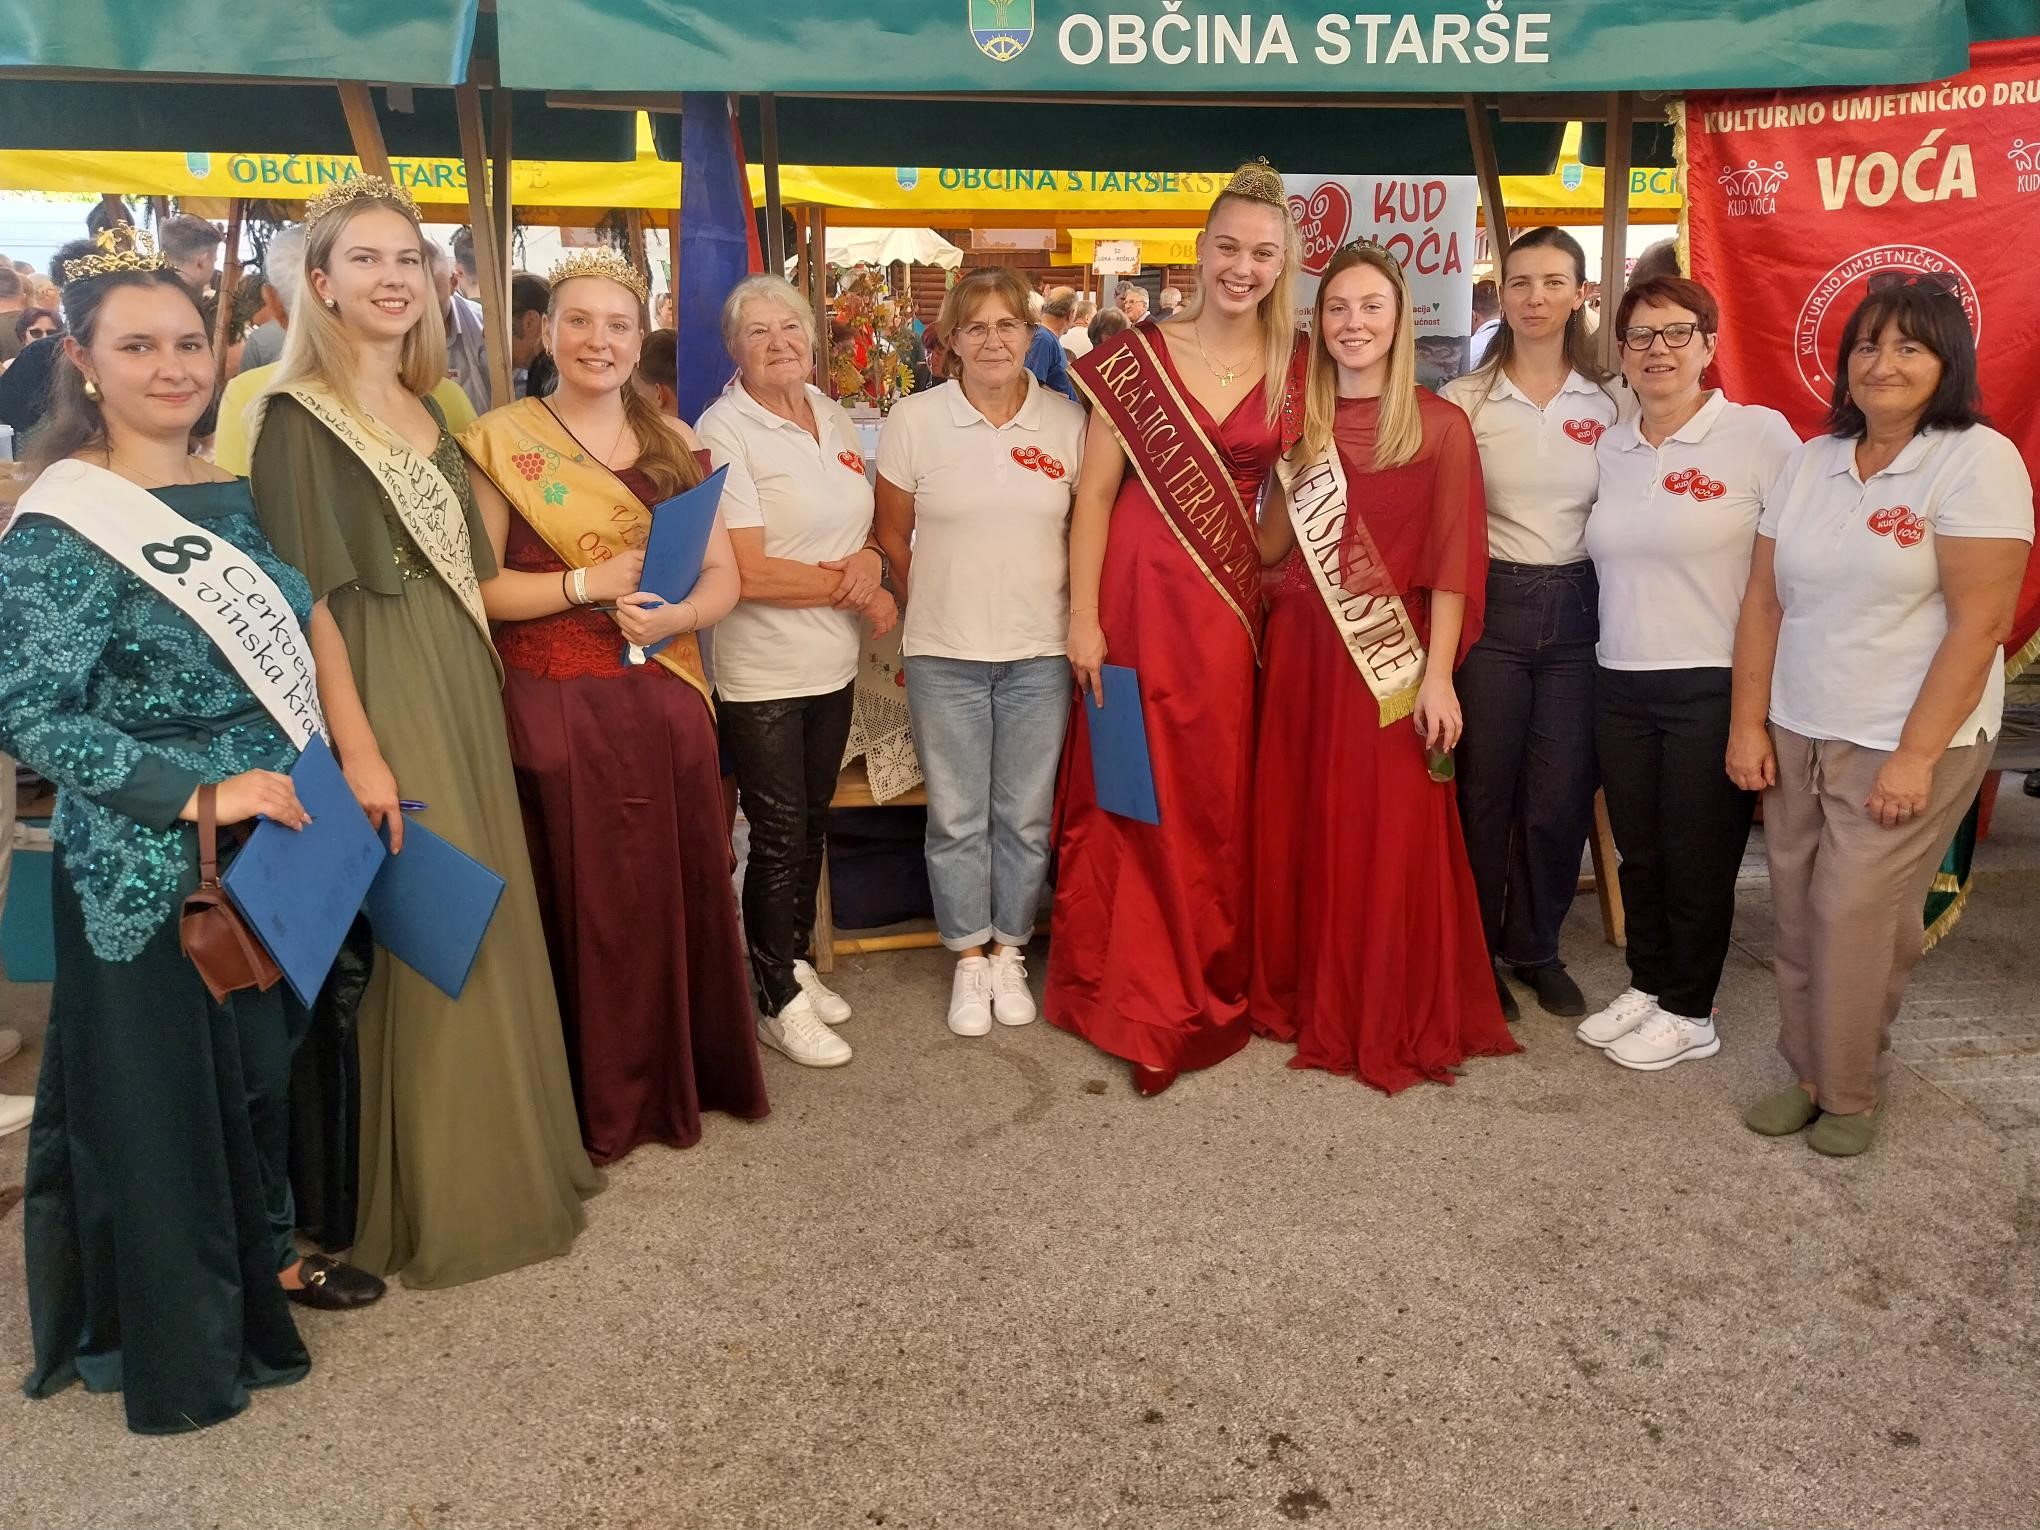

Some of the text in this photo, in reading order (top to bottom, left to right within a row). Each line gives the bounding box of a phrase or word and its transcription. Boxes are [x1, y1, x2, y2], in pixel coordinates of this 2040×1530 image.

[1058, 0, 1551, 66] OBČINA STARŠE
[1705, 101, 1826, 134] KULTURNO
[1832, 81, 1987, 122] UMJETNIČKO
[1816, 127, 1978, 211] VOĆA
[2017, 173, 2040, 193] KUD
[1373, 180, 1448, 224] KUD
[1727, 193, 1776, 217] KUD VOĆA
[1303, 235, 1336, 259] OĆA
[1359, 226, 1463, 276] OĆA
[1412, 303, 1431, 314] acija
[1414, 317, 1441, 326] ućnost
[1801, 249, 1944, 356] KULTURNO UMJETNIČKO
[1096, 342, 1185, 474] KRALJICA
[1164, 455, 1240, 563] TERANA
[1876, 518, 1895, 529] KUD
[1284, 447, 1420, 683] VENSKE ISTRE
[197, 580, 318, 737] vinska kra
